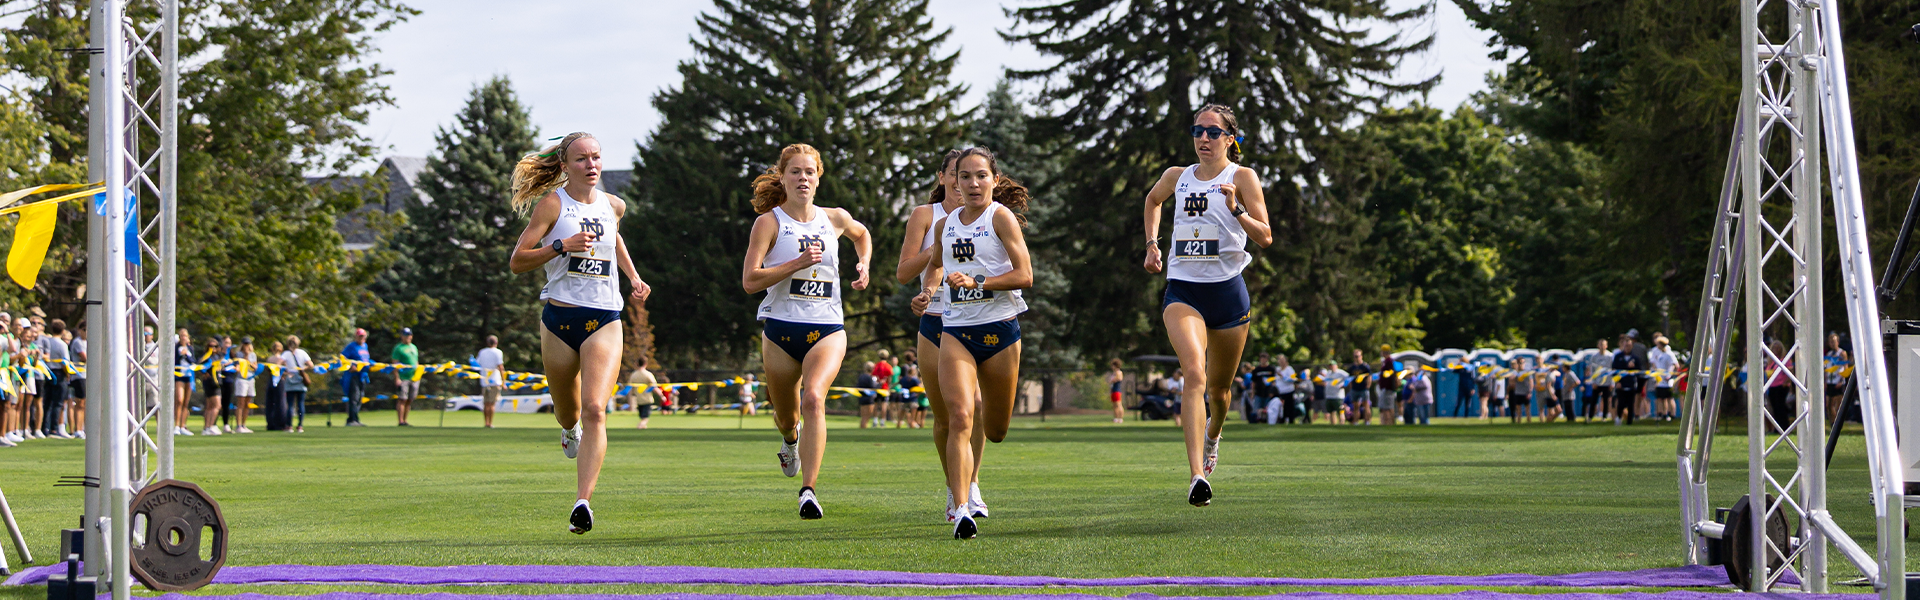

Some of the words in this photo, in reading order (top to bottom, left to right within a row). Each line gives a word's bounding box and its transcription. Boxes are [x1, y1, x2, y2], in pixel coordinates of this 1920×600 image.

[1184, 240, 1206, 255] 421
[578, 259, 602, 274] 425
[800, 281, 824, 296] 424
[143, 491, 178, 511] IRON
